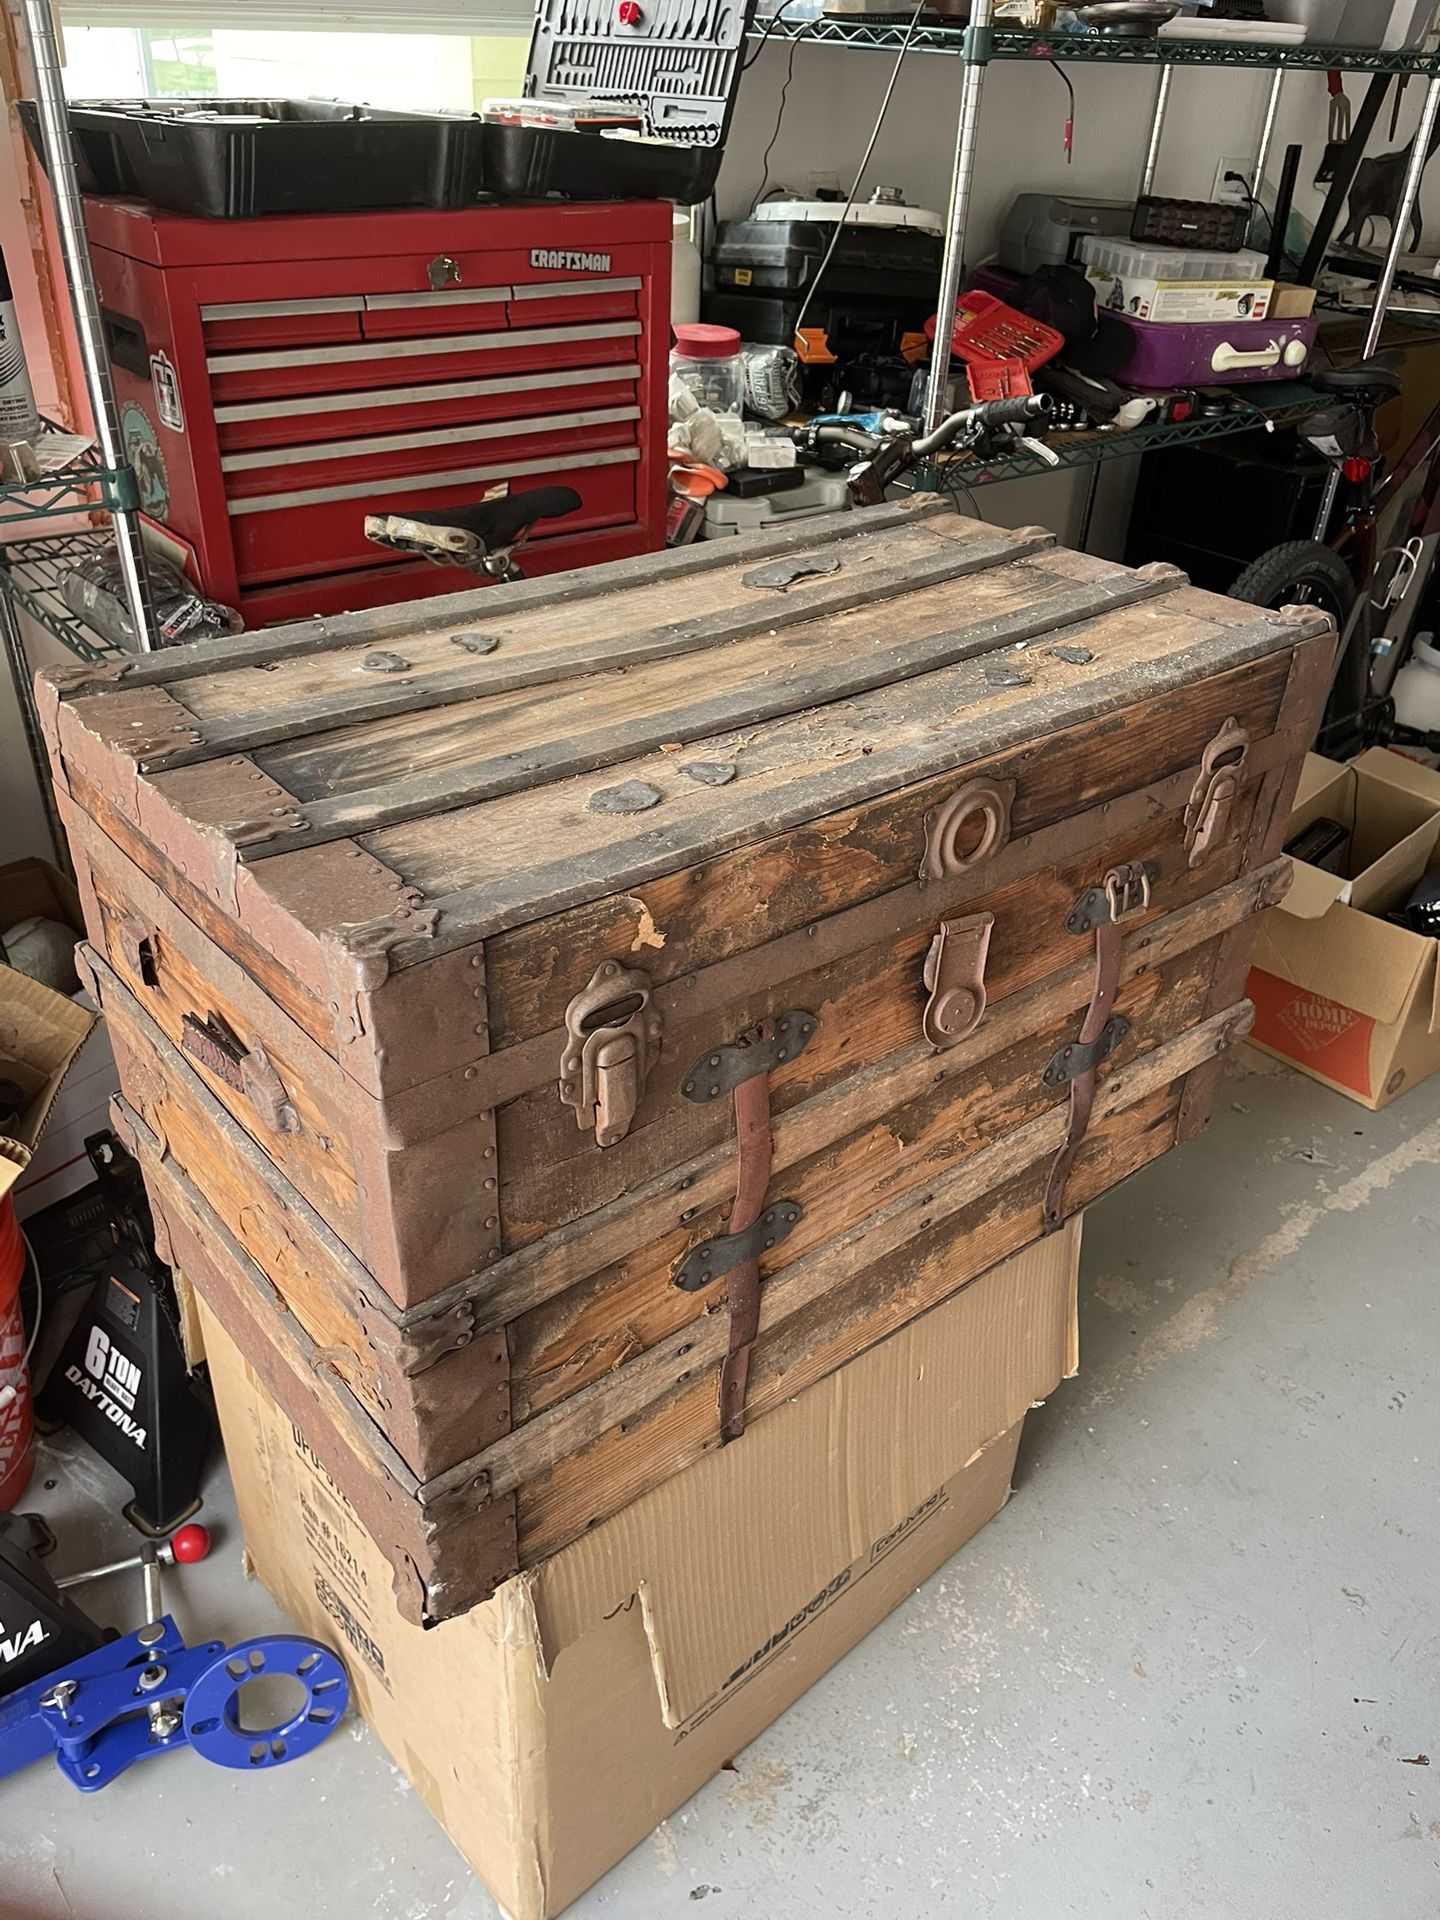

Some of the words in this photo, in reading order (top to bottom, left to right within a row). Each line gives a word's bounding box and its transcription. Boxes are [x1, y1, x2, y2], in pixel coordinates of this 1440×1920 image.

[531, 249, 611, 272] CRAFTSMAN
[1293, 1000, 1352, 1025] HOME
[85, 1325, 110, 1380] 6
[108, 1346, 142, 1395] TON
[64, 1364, 147, 1450] DAYTONA
